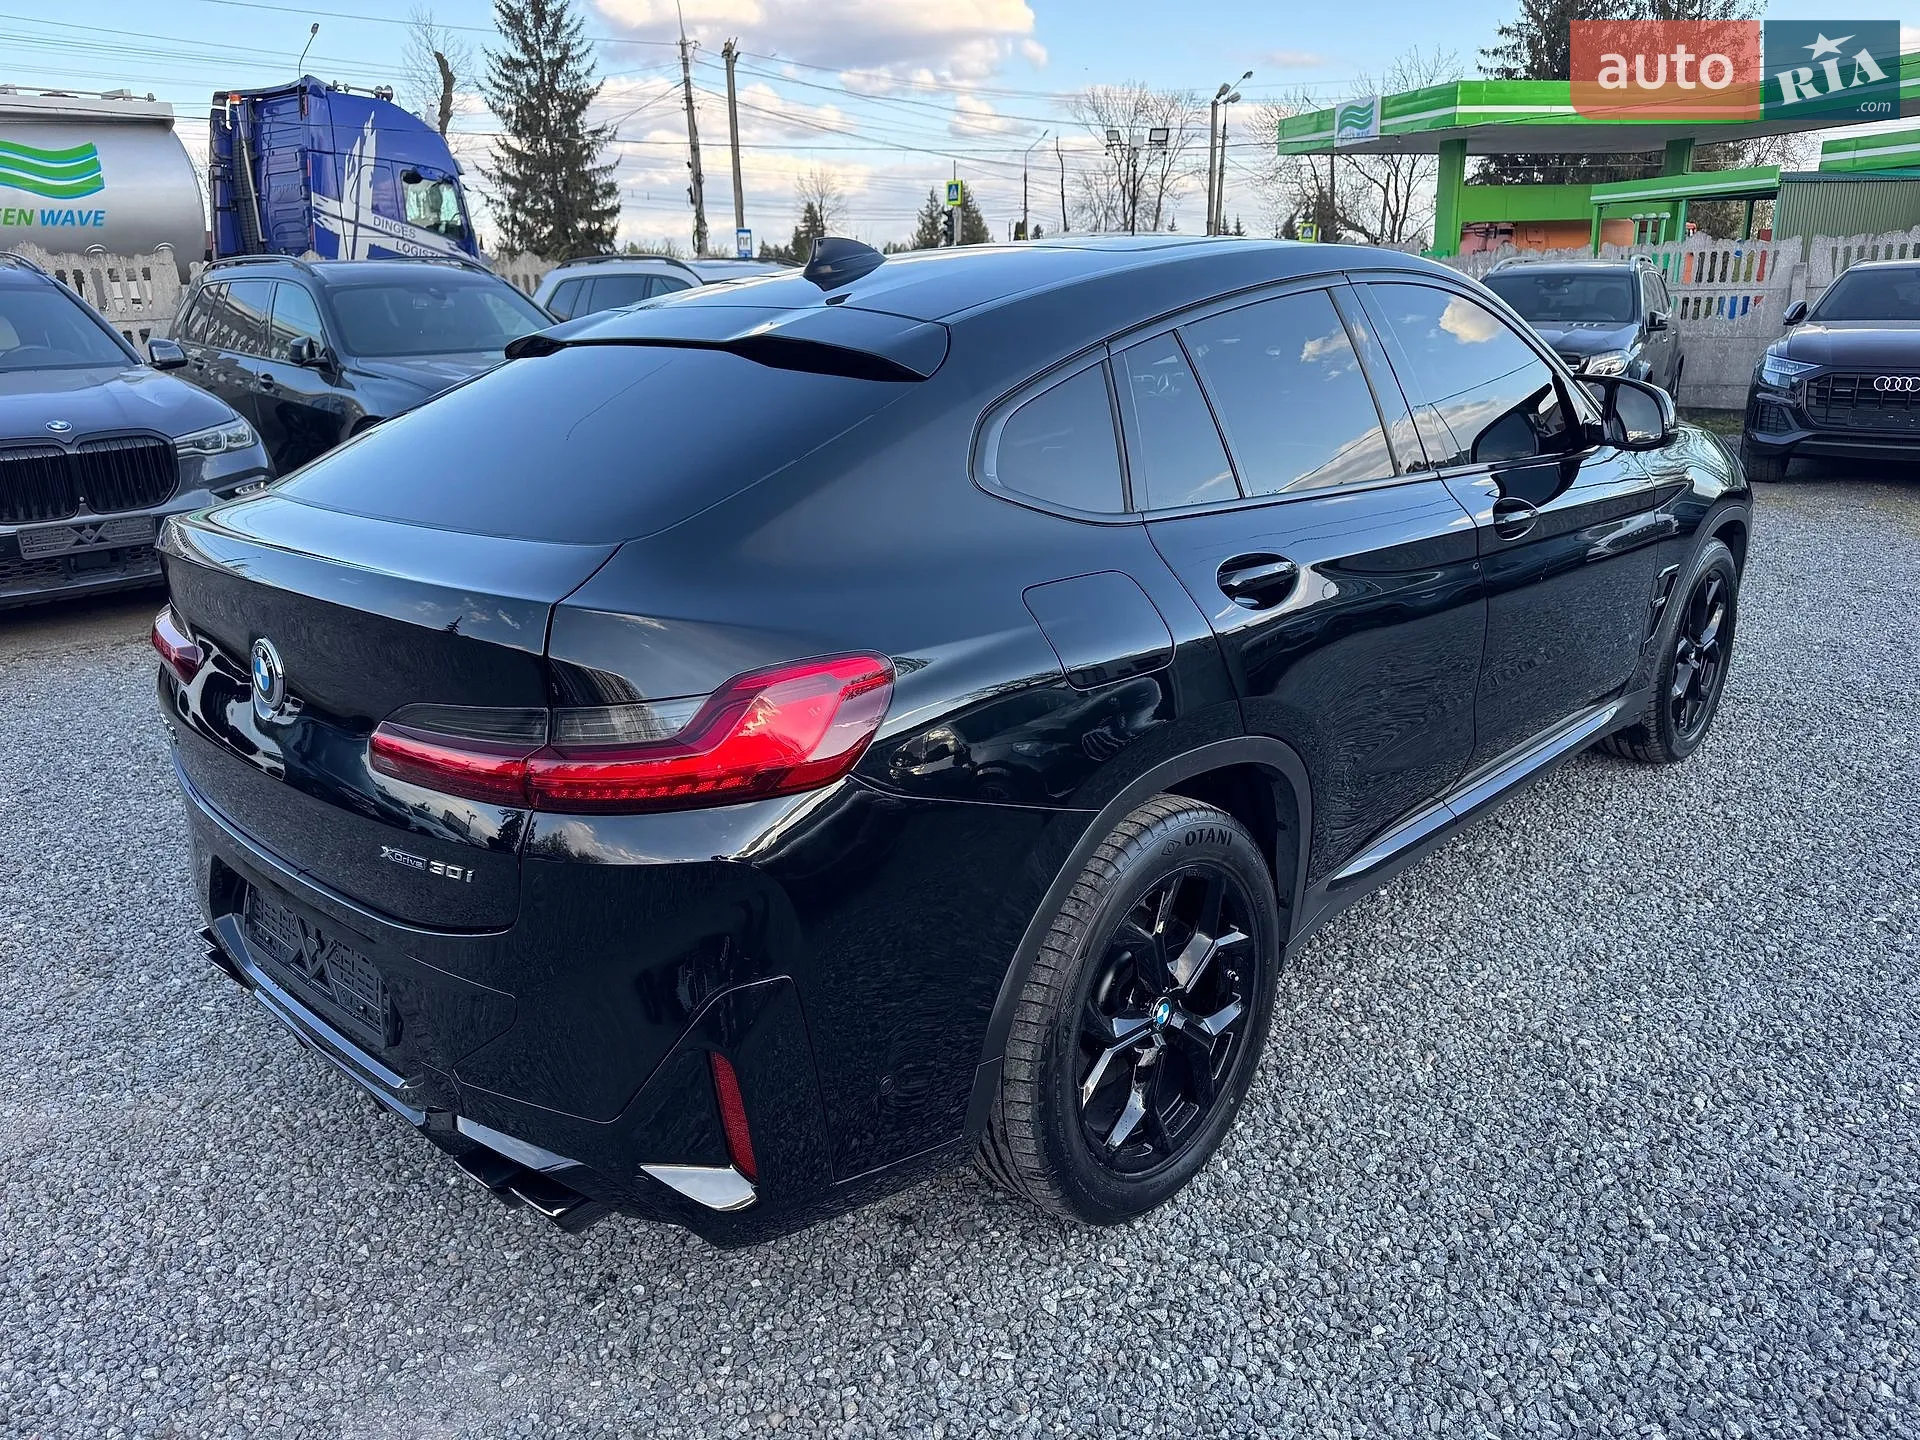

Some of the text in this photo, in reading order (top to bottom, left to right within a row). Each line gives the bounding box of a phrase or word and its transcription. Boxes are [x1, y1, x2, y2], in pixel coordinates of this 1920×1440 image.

[0, 207, 106, 227] EN WAVE
[373, 216, 416, 239] DINGES
[1185, 827, 1232, 846] OTANI
